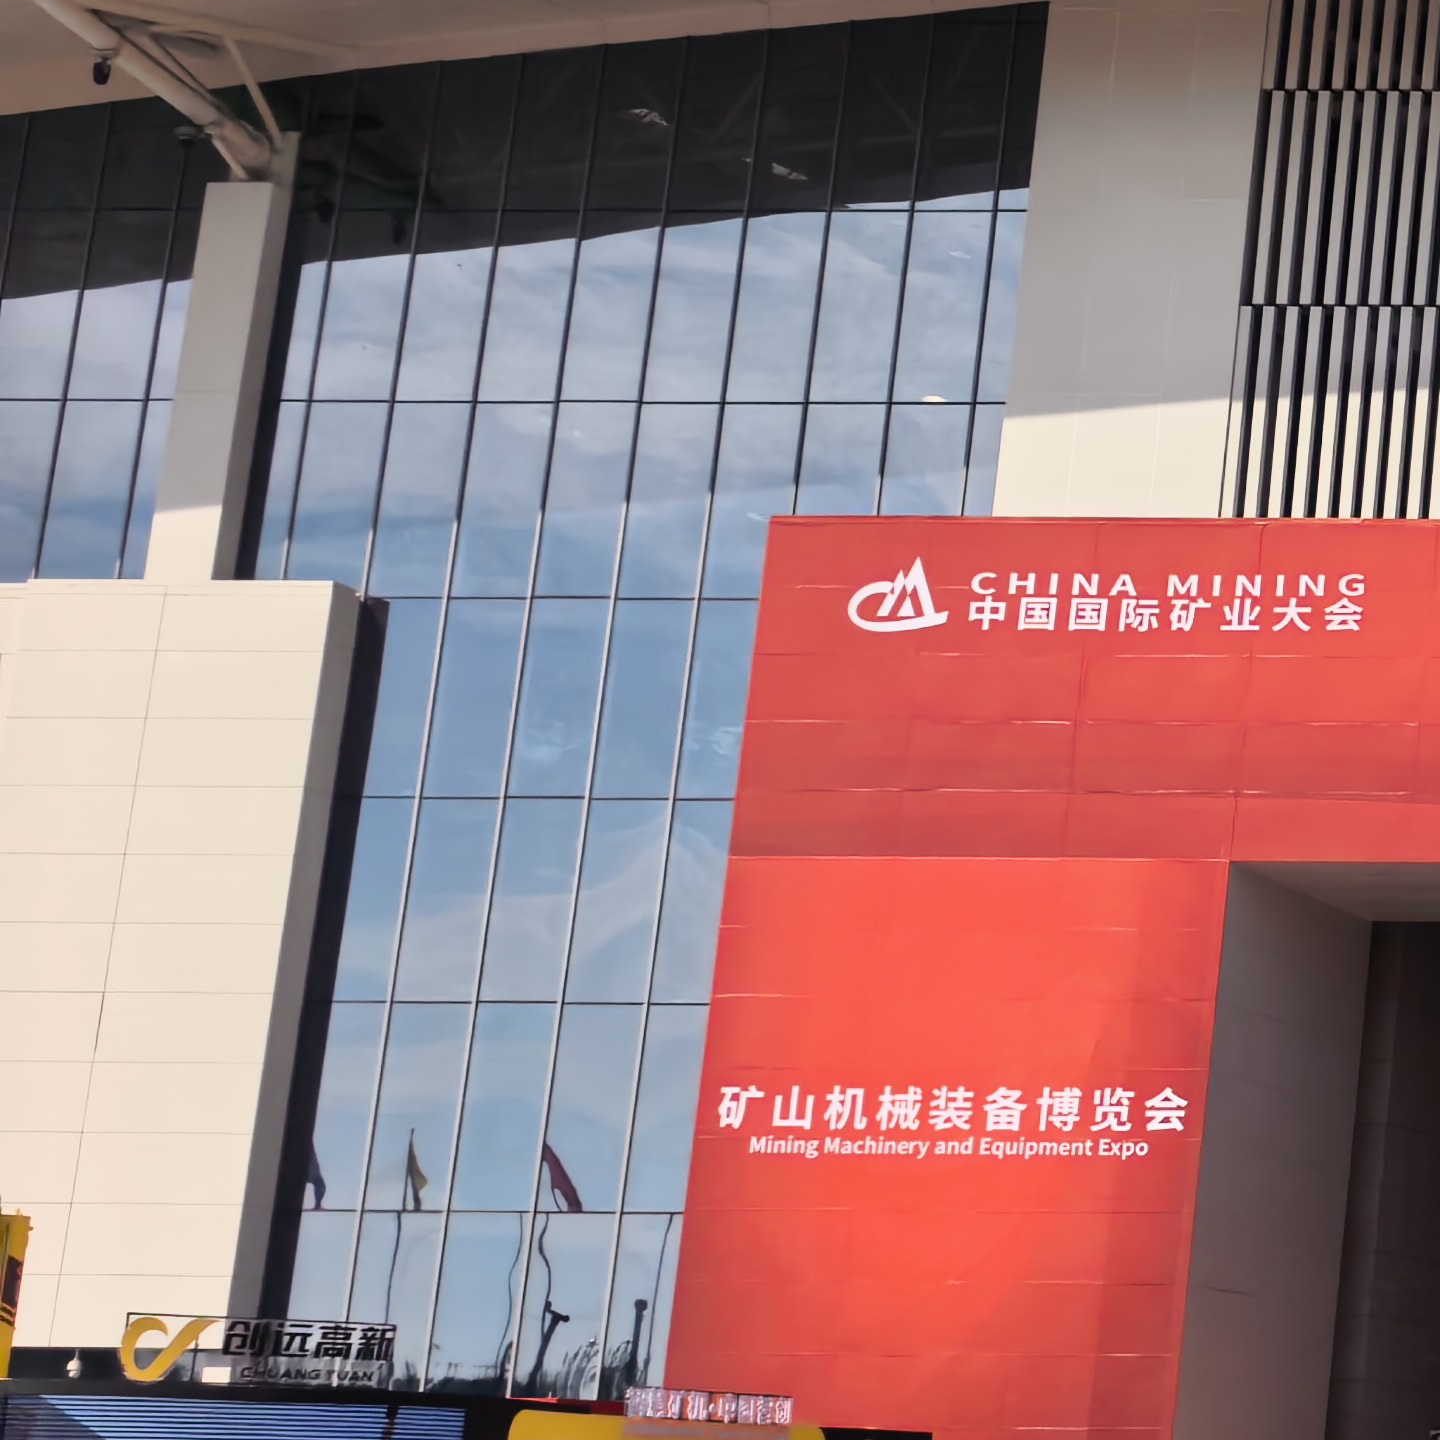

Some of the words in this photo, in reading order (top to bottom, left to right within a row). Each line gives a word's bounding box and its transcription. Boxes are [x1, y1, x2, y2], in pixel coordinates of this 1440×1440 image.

[972, 573, 1136, 596] CHINA
[1167, 574, 1364, 596] MINING
[969, 594, 1363, 632] 中国国际矿业大会
[719, 1086, 1188, 1131] 矿山机械装备博览会
[750, 1136, 819, 1158] Mining
[824, 1136, 930, 1159] Machinery
[935, 1137, 973, 1154] and
[980, 1137, 1093, 1159] Equipment
[1098, 1139, 1148, 1160] Expo
